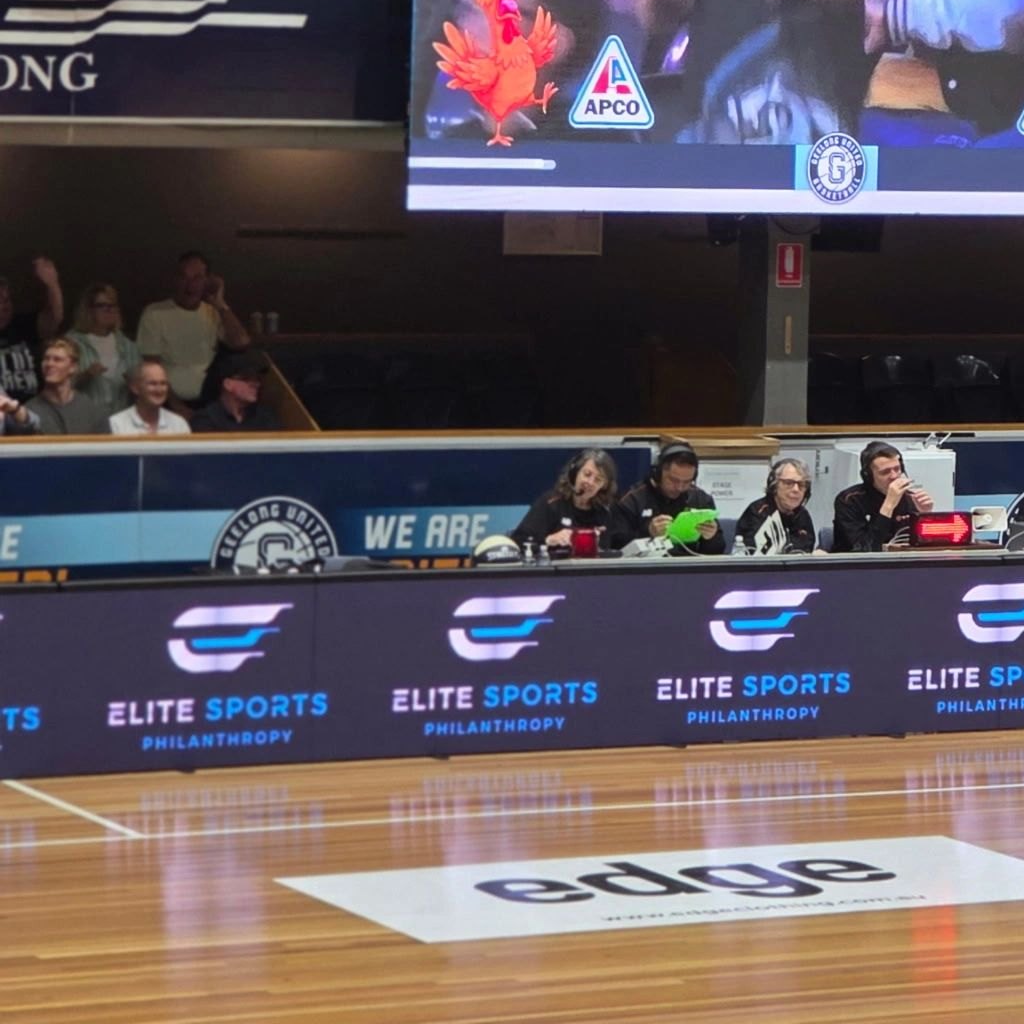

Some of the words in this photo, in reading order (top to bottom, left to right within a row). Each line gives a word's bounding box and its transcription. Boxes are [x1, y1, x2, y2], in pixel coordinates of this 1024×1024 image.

[584, 98, 640, 116] APCO
[220, 504, 279, 558] GEELONG
[286, 506, 331, 557] UNITED
[364, 514, 417, 550] WE
[424, 513, 490, 549] ARE
[657, 675, 733, 701] ELITE
[742, 671, 851, 697] SPORTS
[907, 666, 980, 691] ELITE
[107, 698, 195, 727] ELITE
[205, 692, 328, 721] SPORTS
[392, 685, 473, 713] ELITE
[483, 681, 598, 708] SPORTS
[2, 705, 41, 732] TS
[423, 716, 565, 736] PHILANTHROPY
[687, 706, 820, 725] PHILANTHROPY
[142, 729, 293, 750] PHILANTHROPY
[474, 858, 896, 904] edge
